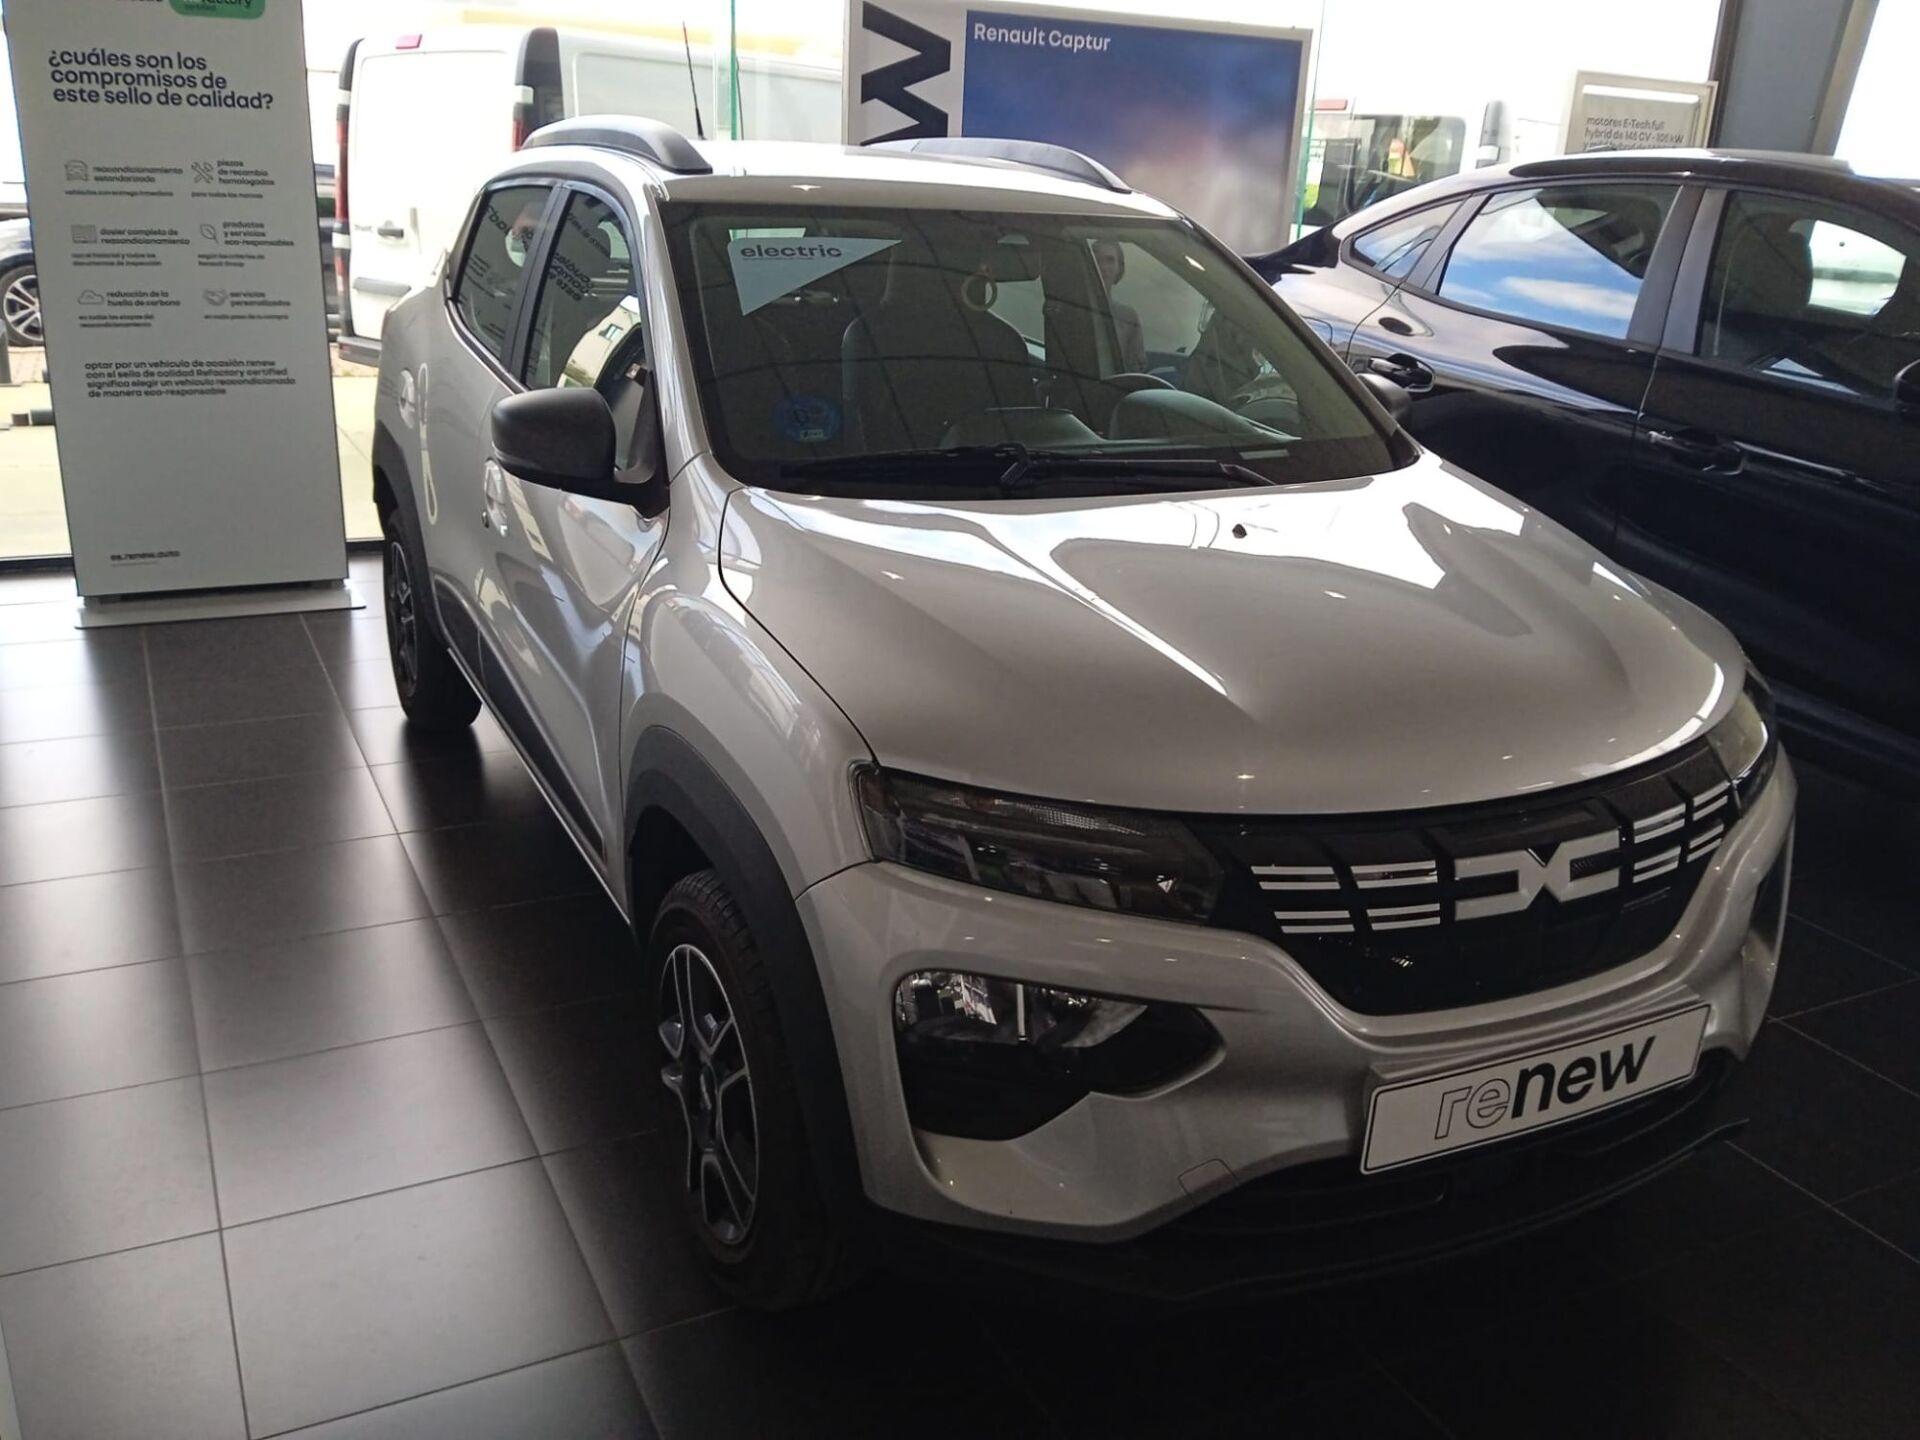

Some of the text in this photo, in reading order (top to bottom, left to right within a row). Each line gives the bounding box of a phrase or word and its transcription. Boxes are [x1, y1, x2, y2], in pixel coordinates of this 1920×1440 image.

[974, 23, 1111, 53] Renault Captur
[49, 48, 207, 70] ¿cuáles son los
[51, 69, 227, 89] compromisos de
[53, 87, 274, 109] este sello de calidad?
[1584, 128, 1613, 140] hybrid
[740, 244, 842, 258] electric
[115, 361, 132, 370] por
[1434, 1035, 1657, 1140] renew
